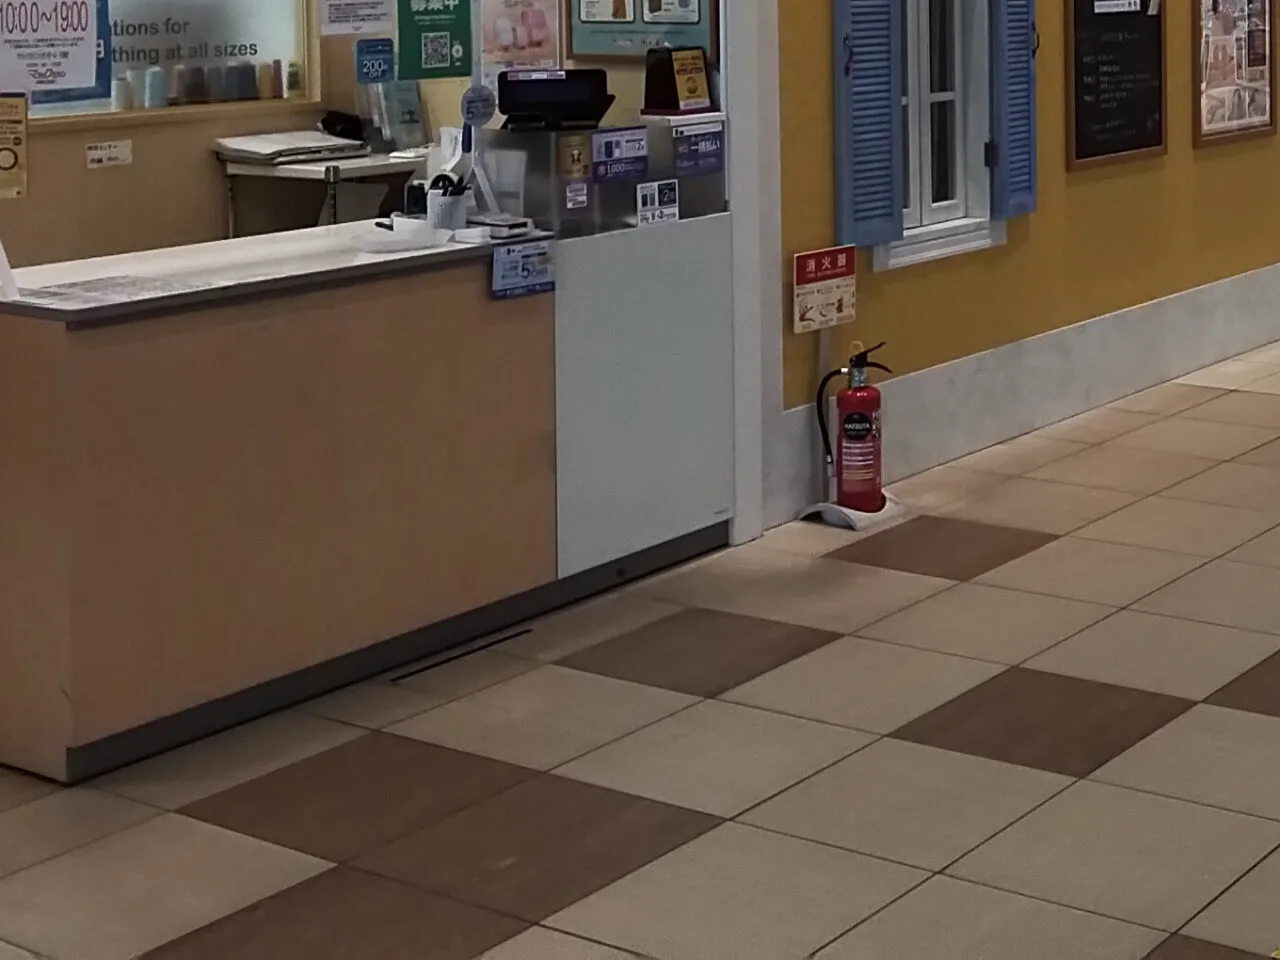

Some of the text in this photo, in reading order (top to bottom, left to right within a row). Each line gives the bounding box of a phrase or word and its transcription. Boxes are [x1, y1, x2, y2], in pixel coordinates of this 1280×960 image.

[111, 18, 189, 36] tions for
[112, 45, 160, 65] thing
[165, 45, 185, 60] at
[189, 44, 208, 58] all
[214, 42, 258, 57] sizes
